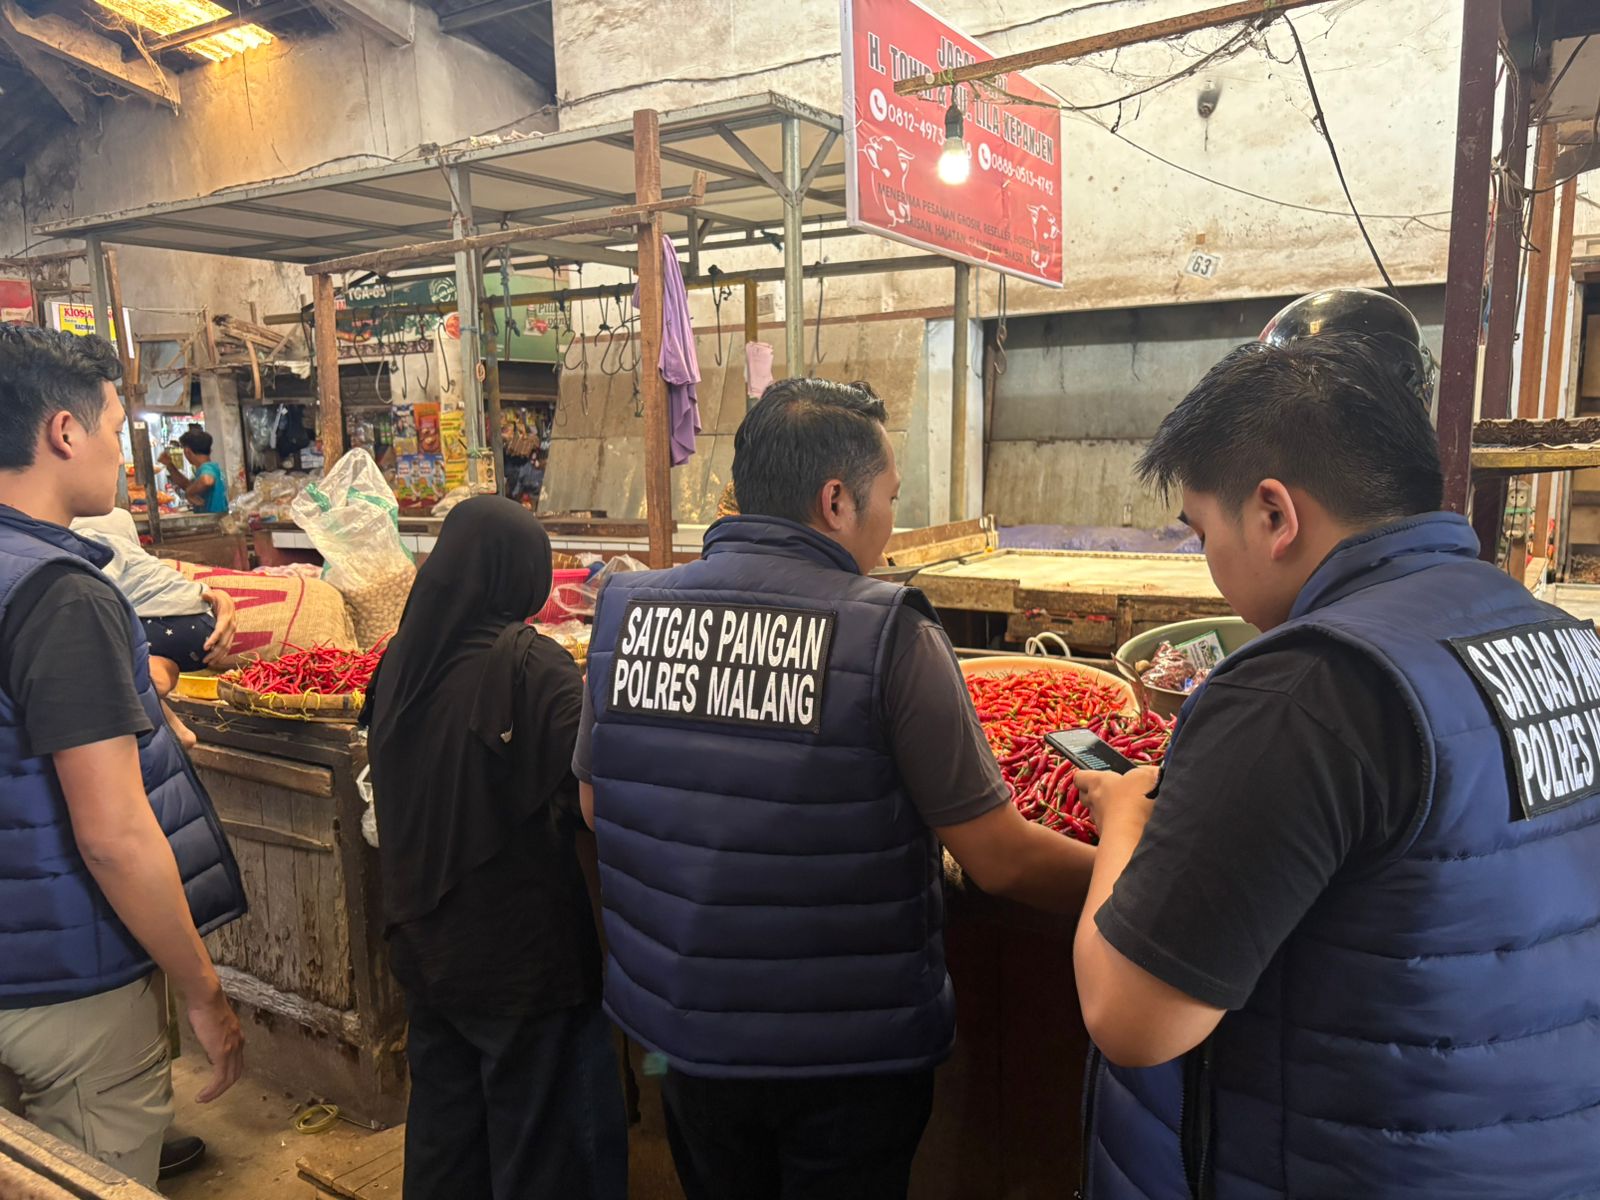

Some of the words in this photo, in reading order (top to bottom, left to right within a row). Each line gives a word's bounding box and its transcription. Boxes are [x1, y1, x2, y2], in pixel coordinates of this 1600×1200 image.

[868, 32, 886, 75] H.
[974, 98, 1000, 138] LILA
[1003, 110, 1054, 166] KEPANJEN
[923, 200, 956, 220] PESANAN
[1192, 255, 1212, 276] 63
[64, 307, 86, 319] KIOS
[621, 606, 714, 661] SATGAS
[716, 610, 827, 671] PANGAN
[612, 658, 700, 713] POLRES
[706, 666, 815, 726] MALANG
[1467, 631, 1577, 721] SATGAS
[1513, 713, 1594, 806] POLRES
